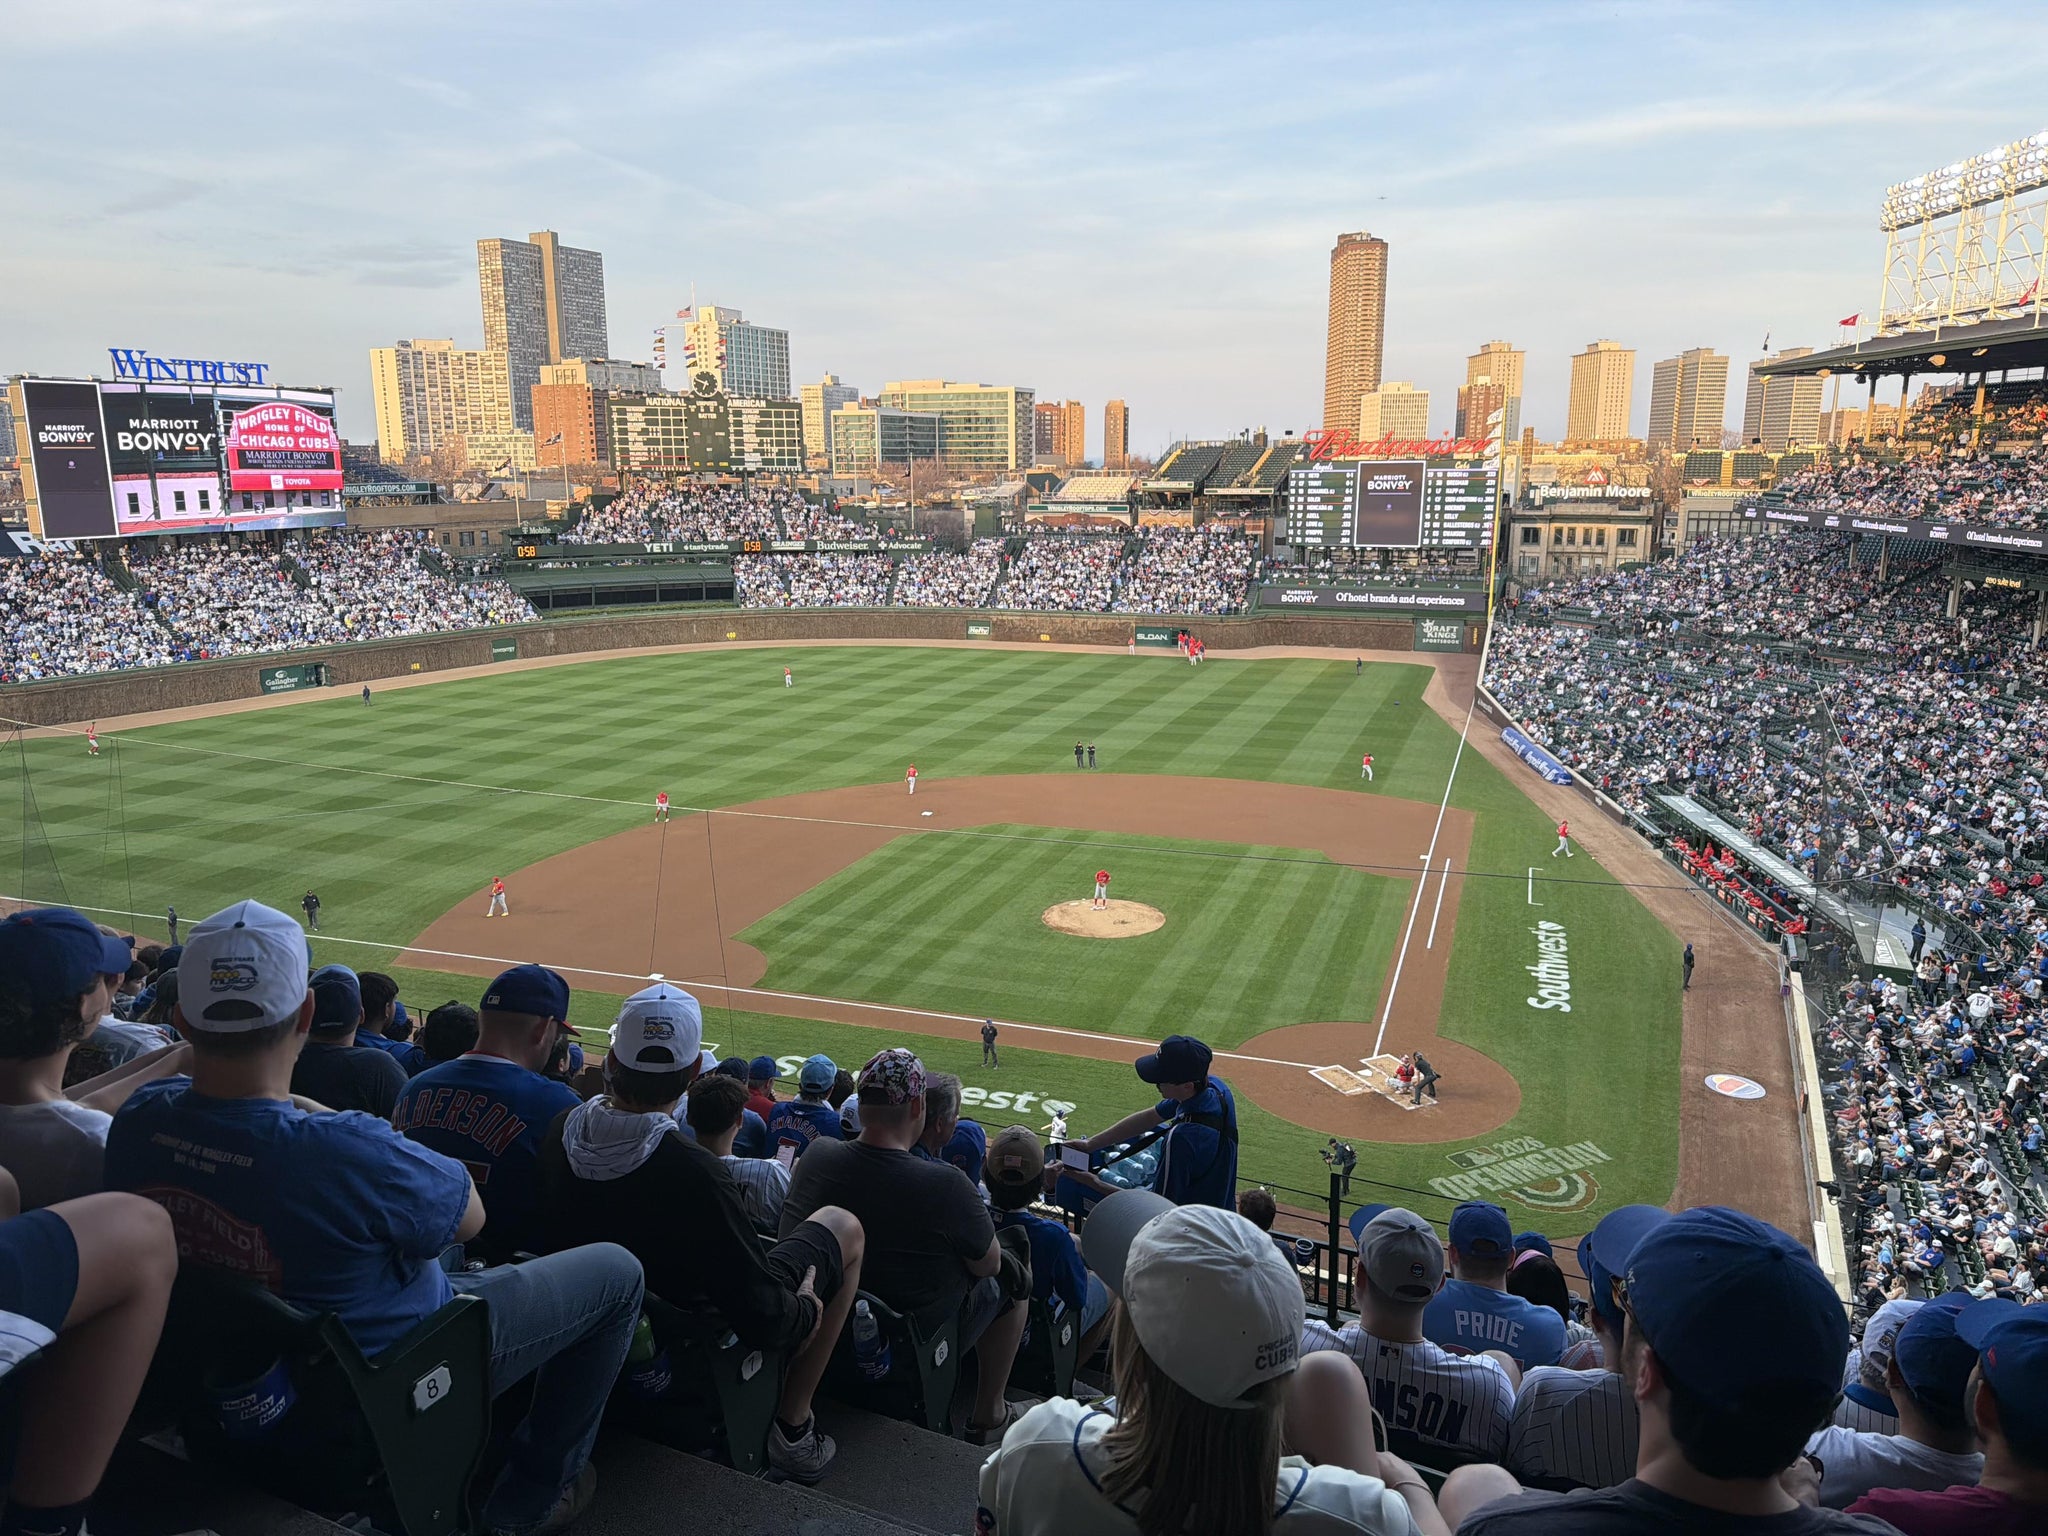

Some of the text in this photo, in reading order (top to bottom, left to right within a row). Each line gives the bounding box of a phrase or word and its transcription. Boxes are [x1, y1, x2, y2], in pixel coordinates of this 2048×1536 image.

[108, 348, 268, 385] WINTRUST
[645, 398, 687, 406] NATIONAL
[727, 399, 767, 408] AMERICAN
[129, 419, 199, 430] MARRIOTT
[238, 408, 328, 434] WRIGLEY FIELD
[44, 424, 86, 432] MARRIOTT
[264, 424, 290, 432] HOME
[38, 432, 95, 443] BONVOY
[117, 432, 213, 451] BONVOY
[240, 434, 330, 448] CHICAGO CUBS
[1303, 428, 1493, 461] Budweiser
[246, 451, 328, 460] MARRIOTT BONVOY
[1312, 462, 1334, 473] Angels
[284, 478, 312, 486] TOYOTA
[1367, 480, 1412, 490] BONVOY
[1540, 485, 1651, 500] Benjamin Moore
[644, 543, 673, 552] YETI
[690, 543, 729, 551] tastytrade
[744, 541, 762, 552] 0:58
[816, 542, 867, 550] Budweiser
[888, 542, 922, 550] Advocate
[518, 546, 536, 558] 0:58
[1281, 595, 1318, 604] BONVOY
[1336, 592, 1465, 606] Of hotel brands and experiences
[1423, 624, 1458, 633] DRAFT
[1136, 633, 1168, 641] SLOAN
[266, 676, 298, 688] Gallagher
[1525, 929, 1572, 1012] Southwest
[1493, 1136, 1546, 1158] 2026
[1428, 1140, 1614, 1200] OPENING DAY
[1064, 1328, 1070, 1340] 5
[1454, 1309, 1525, 1348] PRIDE
[1258, 1334, 1293, 1354] CHICAGO
[938, 1347, 944, 1358] 6
[1254, 1343, 1294, 1370] CUBS
[748, 1355, 754, 1372] 7
[426, 1378, 439, 1399] 8
[1364, 1377, 1468, 1444] NSON
